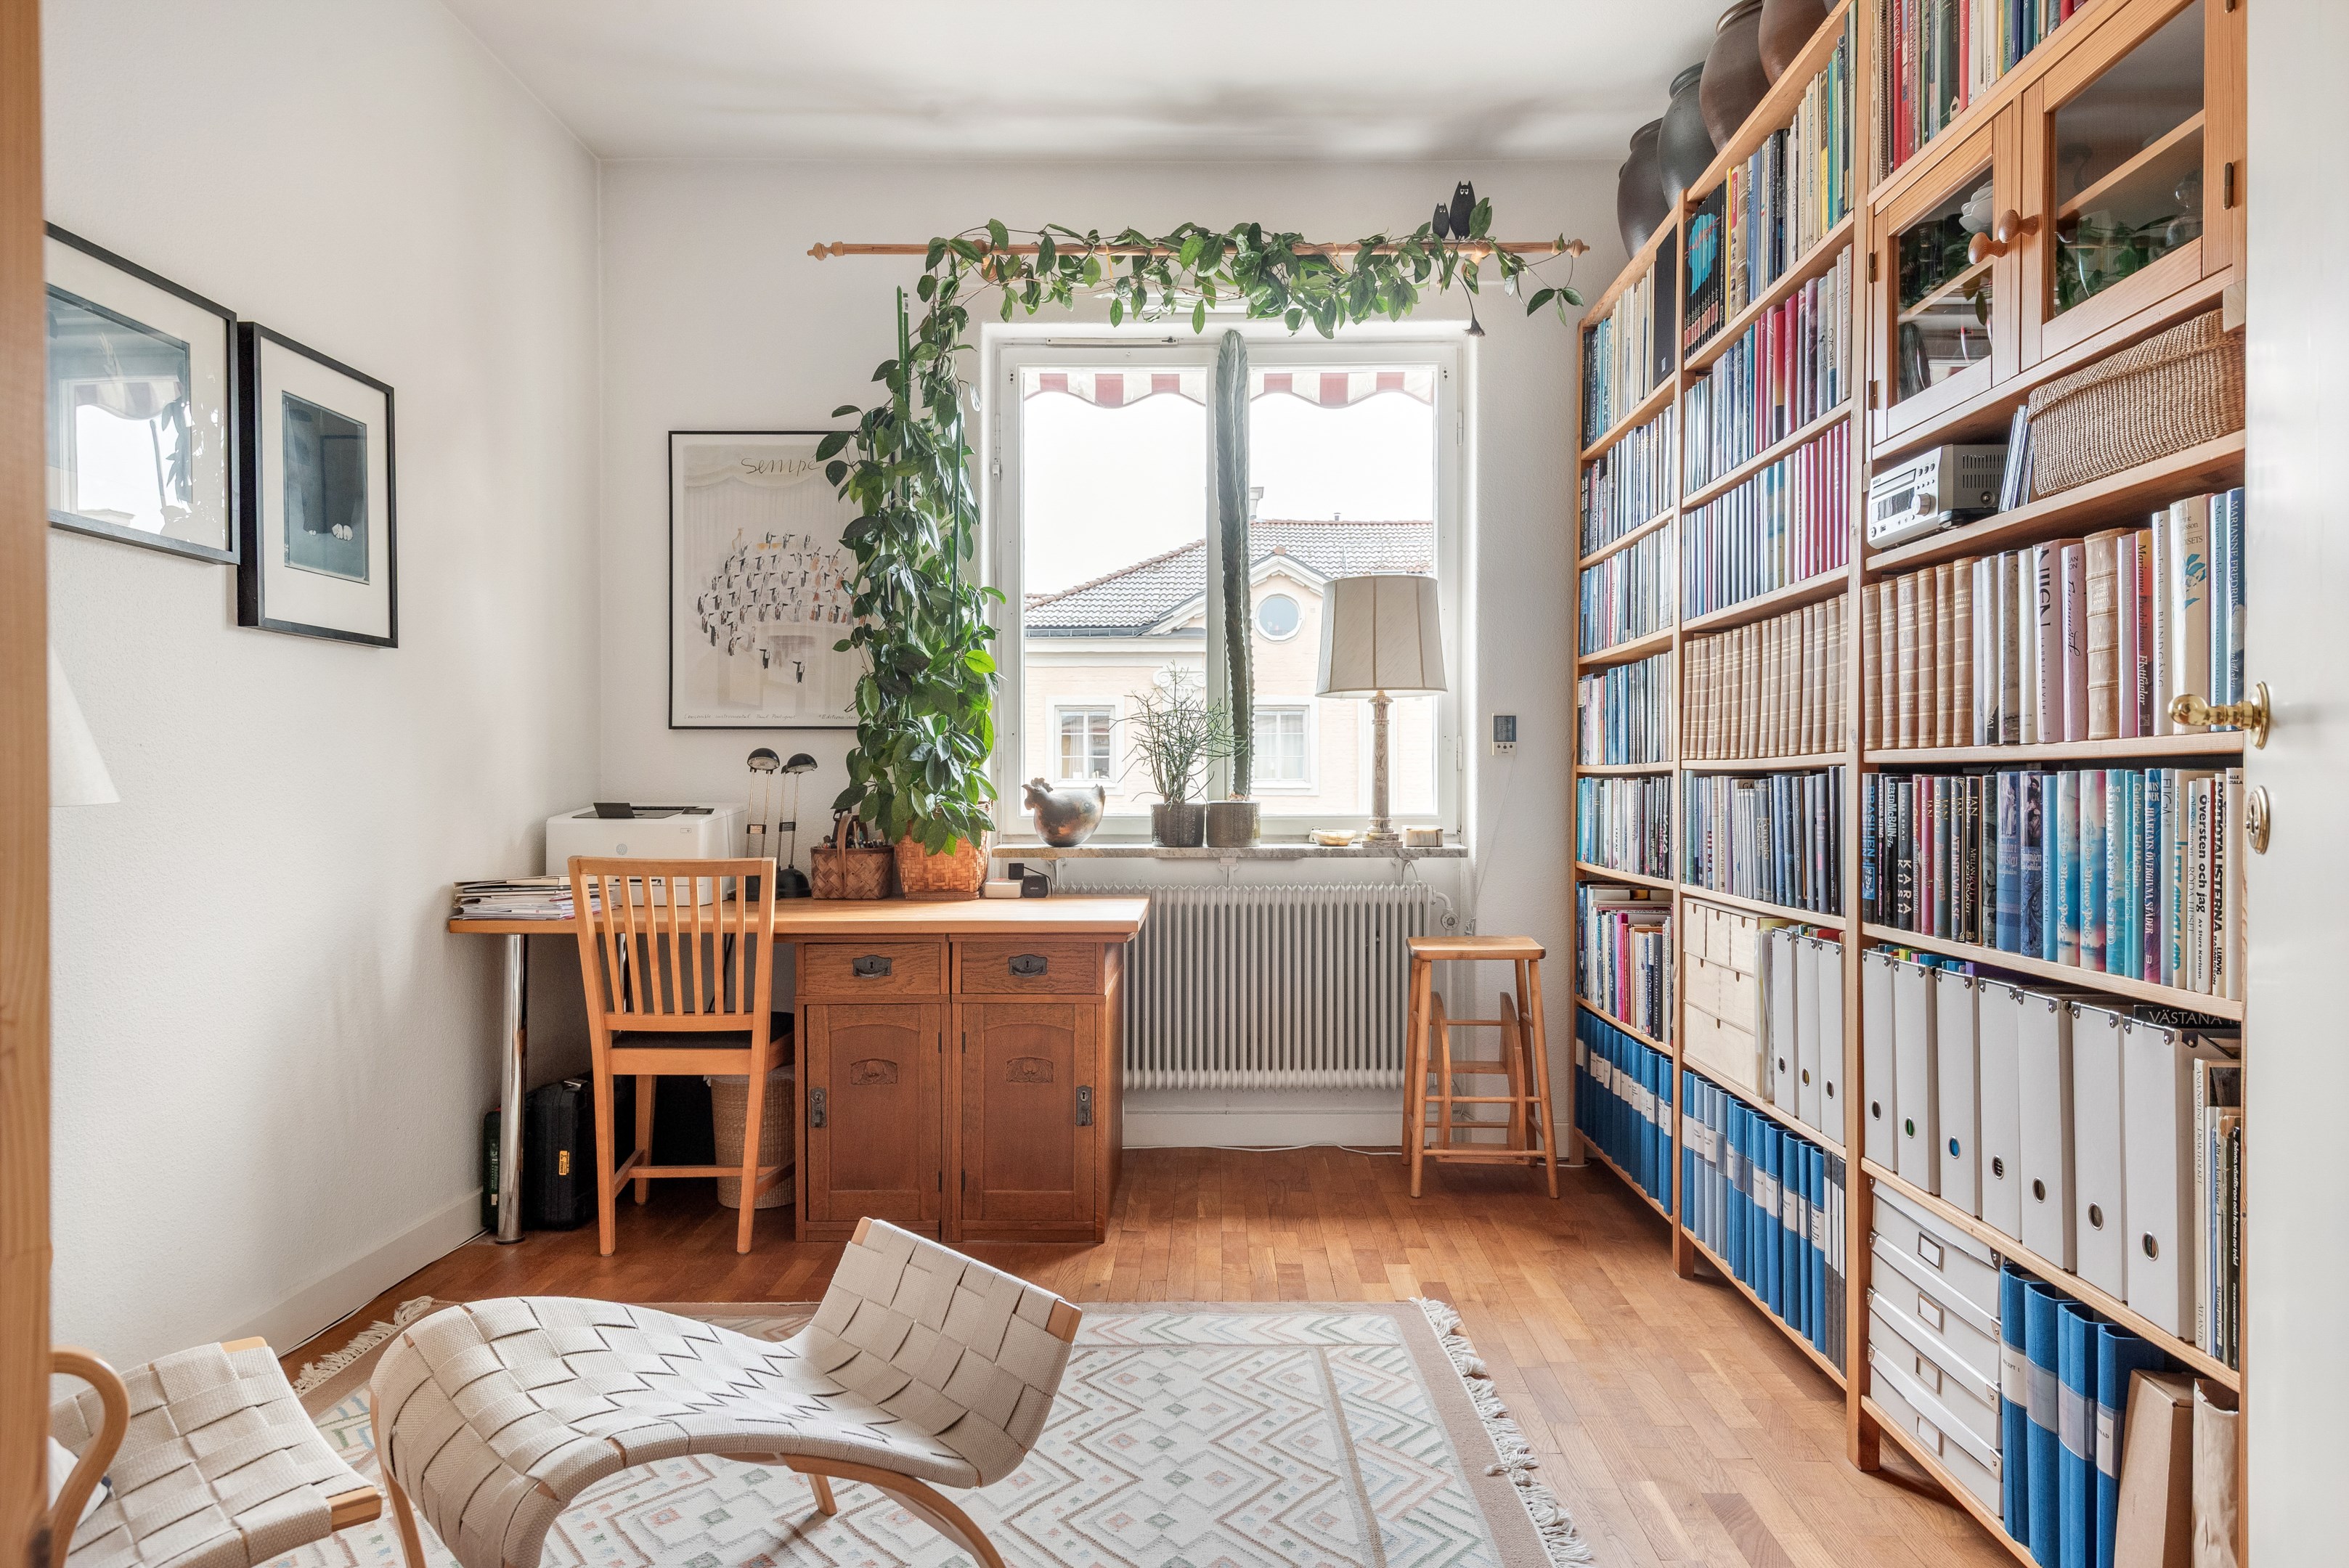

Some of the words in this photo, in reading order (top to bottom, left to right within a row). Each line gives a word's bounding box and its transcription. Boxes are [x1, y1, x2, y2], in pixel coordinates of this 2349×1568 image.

[2230, 501, 2239, 557] MARIANNE
[2138, 544, 2147, 592] Marianne
[2230, 560, 2239, 634] FREDRIKSSON
[2138, 595, 2147, 651] Fredriksson
[2138, 655, 2149, 705] Flyttfåglar
[1867, 785, 1876, 857] BRASILIEN
[2133, 783, 2142, 826] Guldlock
[2133, 834, 2141, 848] Ed
[2199, 794, 2210, 862] Översten
[1903, 859, 1912, 915] KARA
[2059, 863, 2068, 904] Marco
[2083, 866, 2093, 907] Marco
[2145, 852, 2156, 899] ÖVERGIVNA
[2199, 863, 2208, 889] och
[1952, 907, 1959, 920] SE
[2058, 904, 2069, 934] Polo
[2081, 908, 2093, 939] Polo
[2144, 902, 2155, 934] STÄDER
[2197, 892, 2207, 913] jag
[2198, 918, 2203, 928] Av
